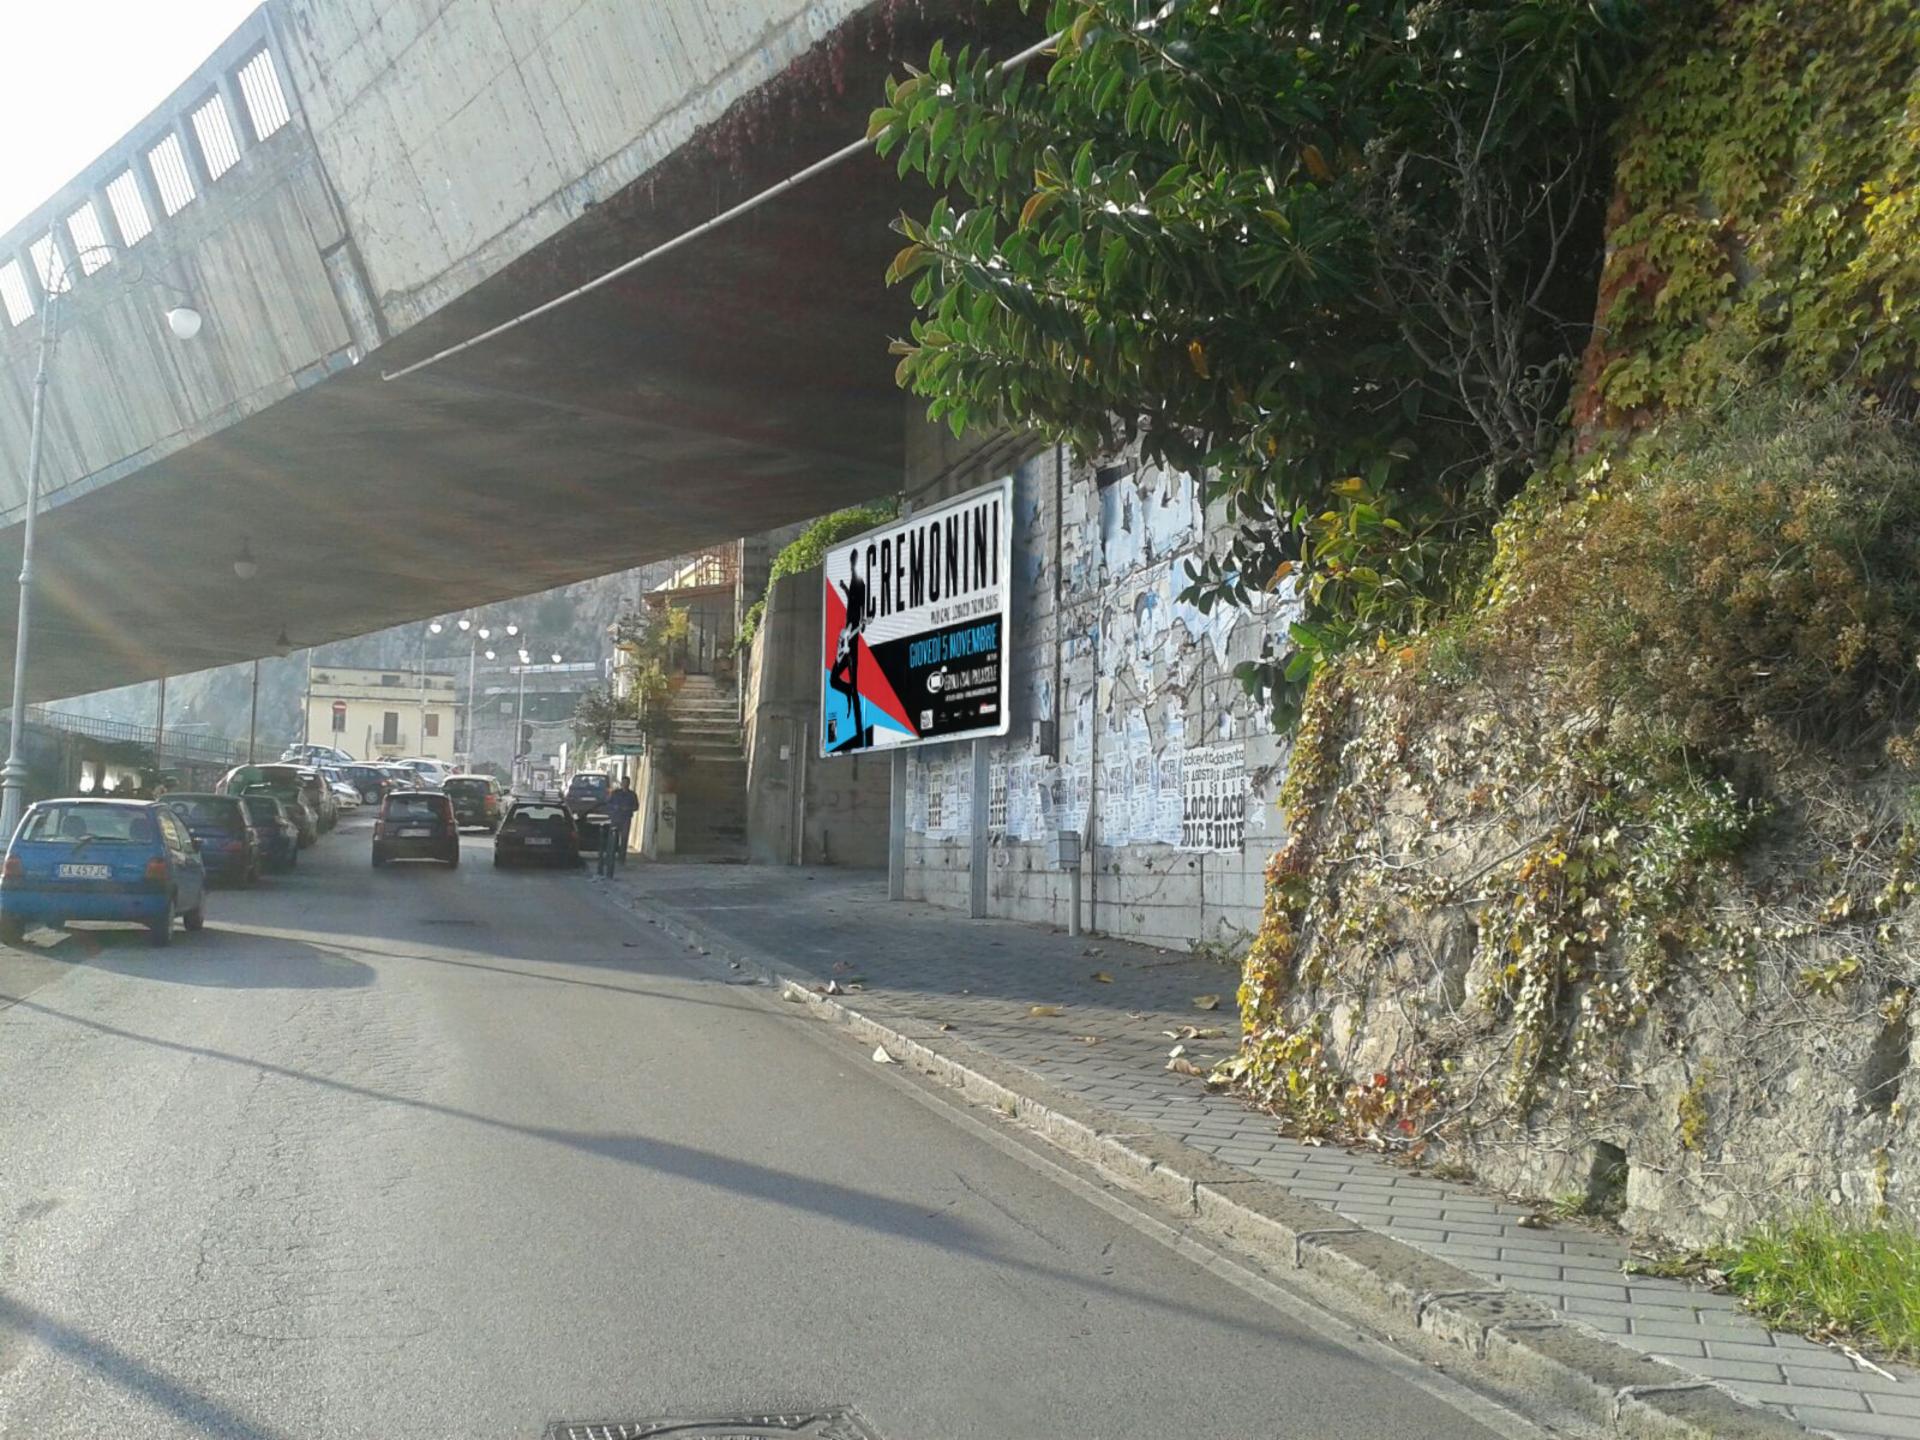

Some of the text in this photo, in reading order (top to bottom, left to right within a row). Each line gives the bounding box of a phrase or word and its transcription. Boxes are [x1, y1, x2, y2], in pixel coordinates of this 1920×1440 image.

[865, 501, 999, 618] CREMONINI
[942, 635, 949, 661] 5
[949, 623, 998, 659] NOVEMBRE
[1183, 795, 1214, 821] LOCO
[1214, 793, 1244, 821] LOCO
[1181, 822, 1214, 848] DICE
[1214, 822, 1244, 849] DICE
